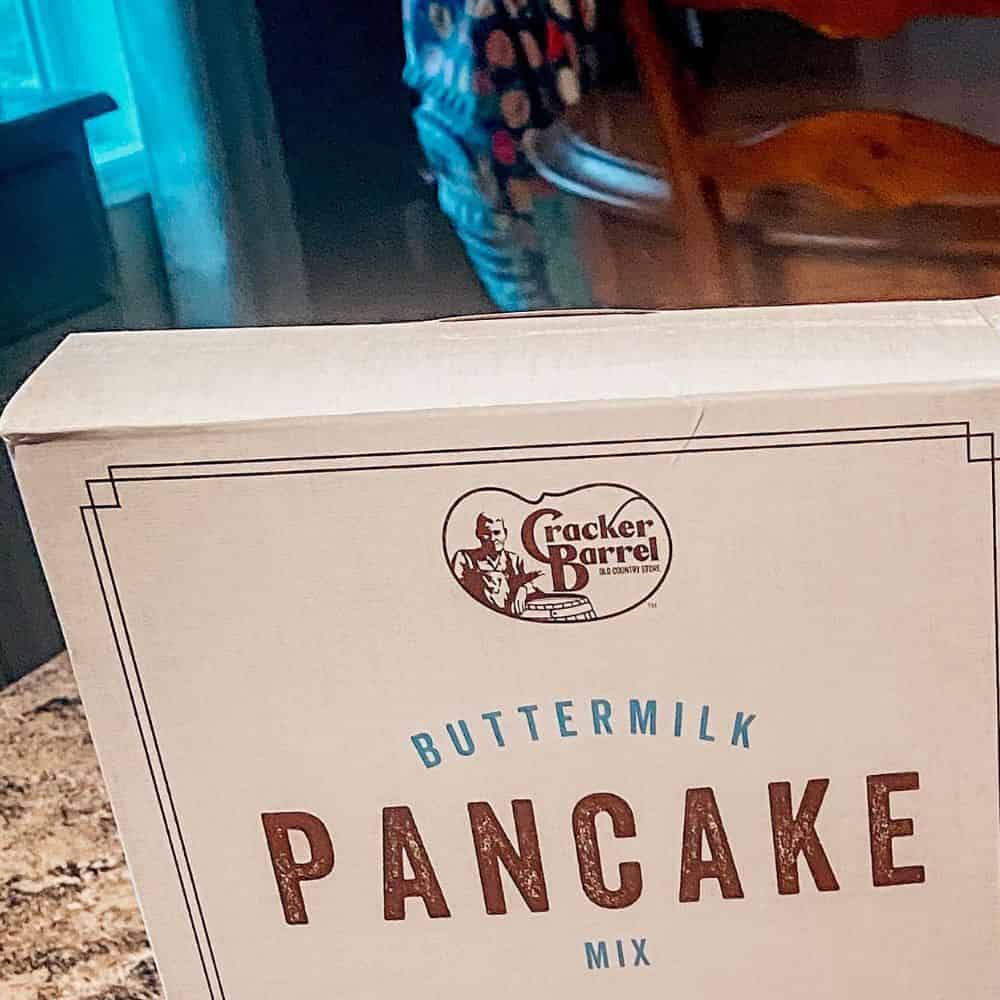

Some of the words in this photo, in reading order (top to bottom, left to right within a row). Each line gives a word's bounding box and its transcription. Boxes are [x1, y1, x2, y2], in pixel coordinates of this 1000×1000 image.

[520, 508, 654, 564] Cracker
[549, 537, 659, 593] Barrel
[410, 698, 756, 769] BUTTERMILK
[260, 771, 926, 925] PANCAKE
[583, 938, 651, 970] MIX
